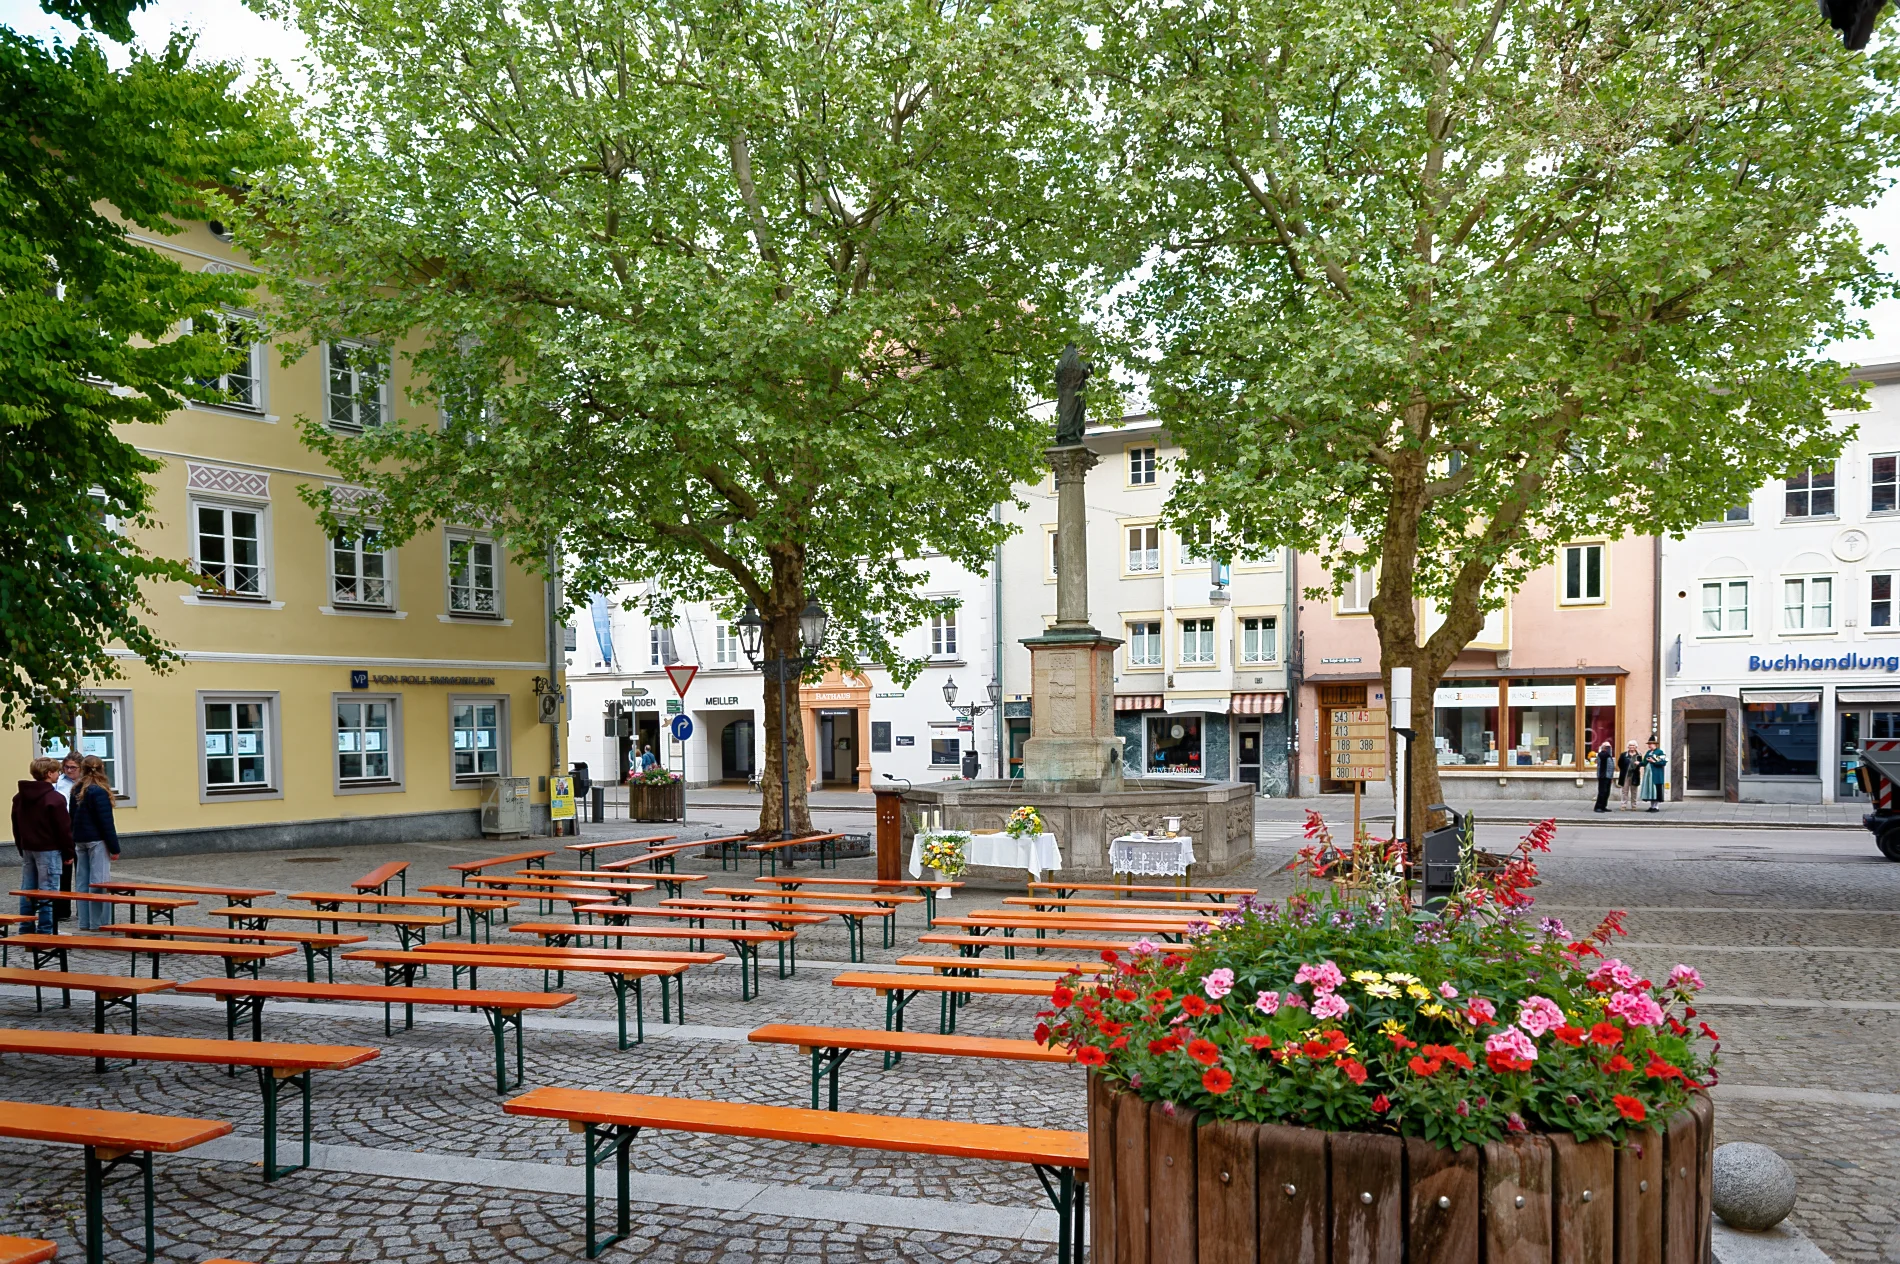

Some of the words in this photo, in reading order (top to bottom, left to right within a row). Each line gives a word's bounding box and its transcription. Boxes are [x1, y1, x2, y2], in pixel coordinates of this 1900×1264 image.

[1749, 653, 1899, 673] Buchhandlung
[353, 674, 367, 684] VP
[373, 675, 398, 684] VON
[401, 675, 427, 685] POLL
[430, 676, 495, 686] IMMOBILIEN
[706, 697, 739, 705] MEILLER
[815, 692, 851, 700] RATHAUS
[604, 699, 656, 707] SCUHMODEN
[1335, 712, 1348, 722] 543
[1335, 726, 1348, 737] 413
[1337, 740, 1350, 750] 188
[1360, 740, 1373, 750] 388
[1337, 753, 1350, 764] 403
[1337, 767, 1349, 778] 380
